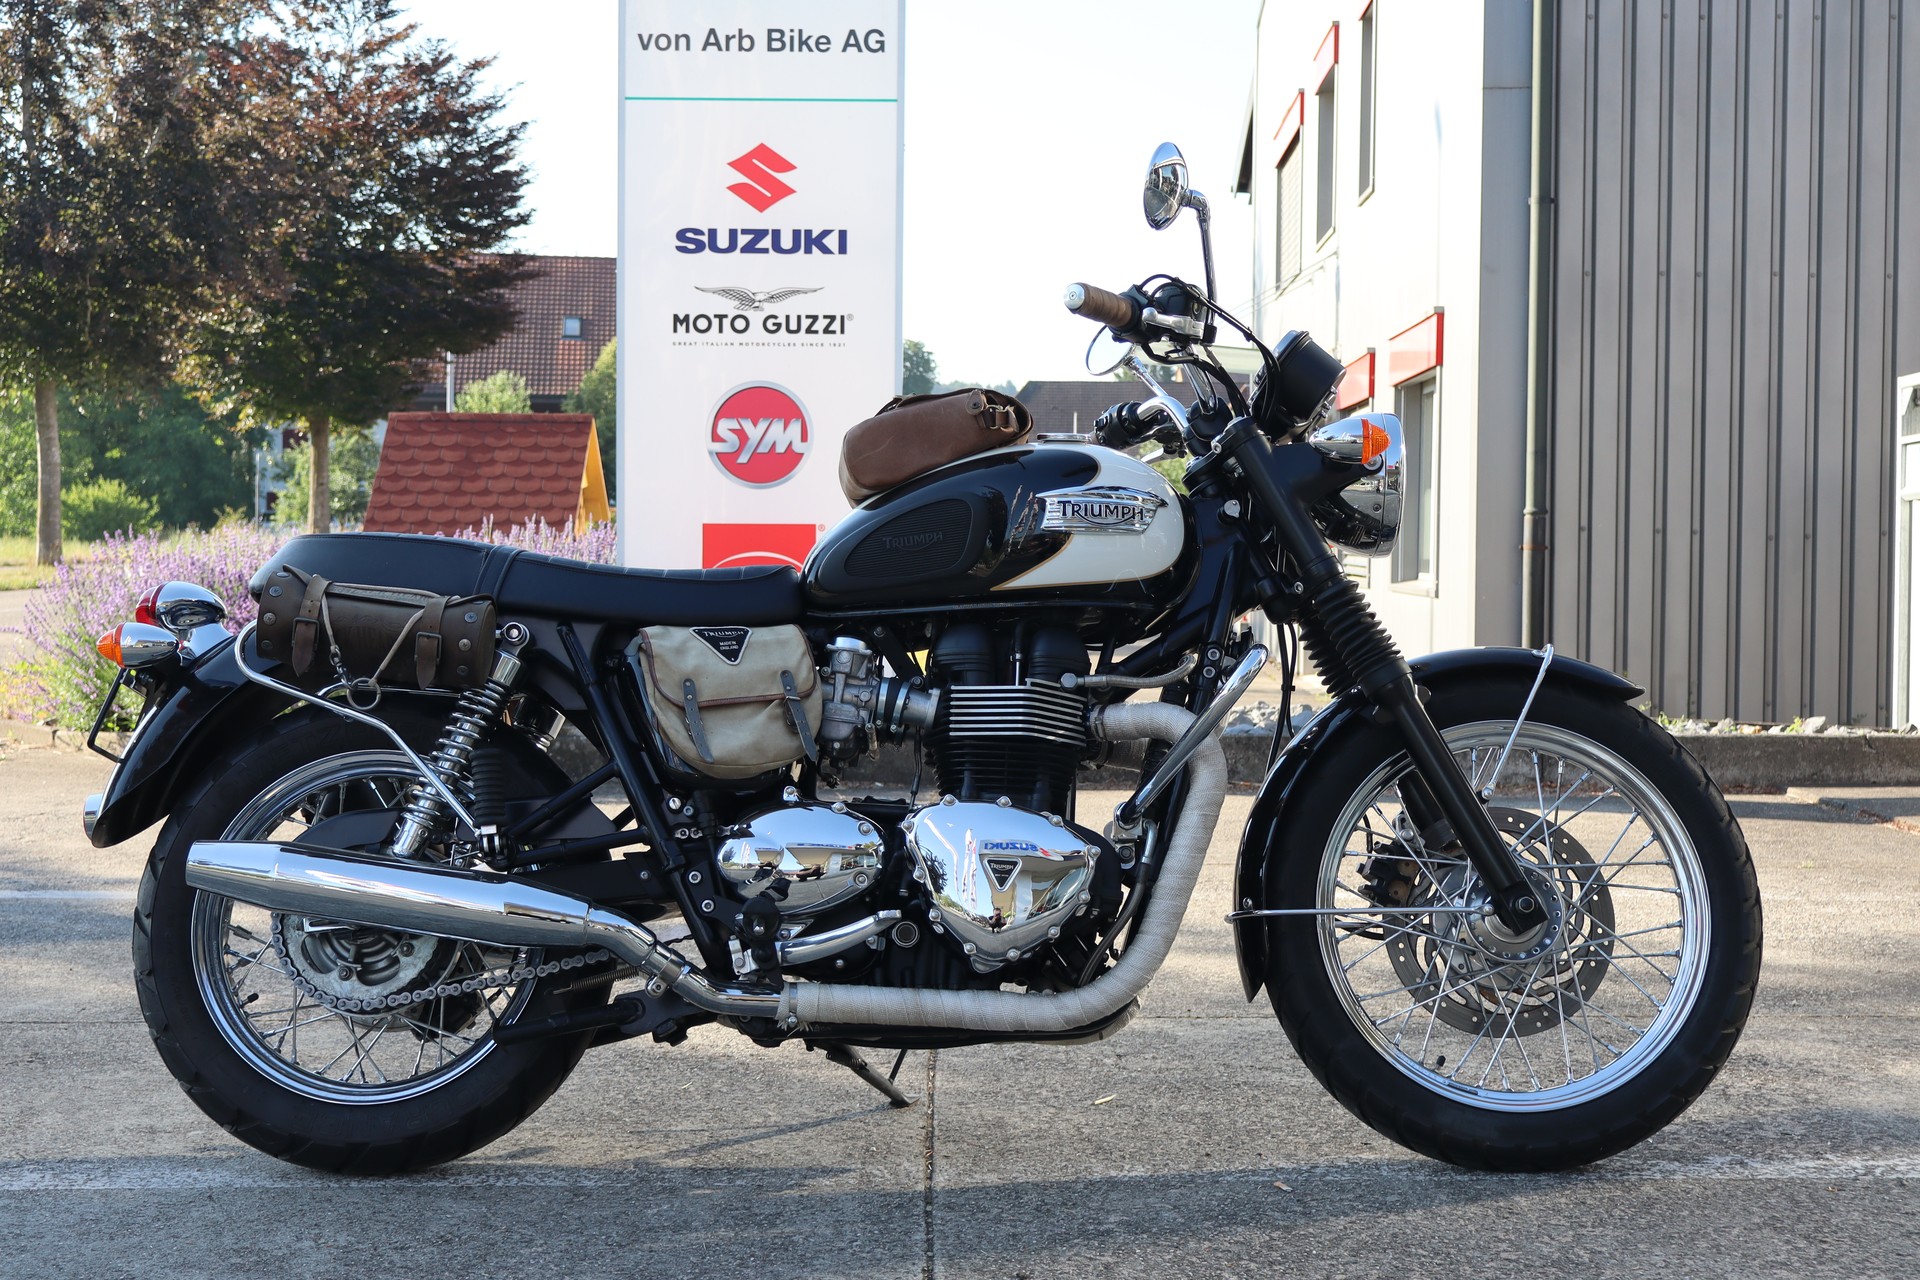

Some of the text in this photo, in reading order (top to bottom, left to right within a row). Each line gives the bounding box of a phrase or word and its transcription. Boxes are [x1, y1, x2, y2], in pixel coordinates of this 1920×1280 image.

[637, 28, 886, 53] von Arb Bike AG
[674, 227, 848, 255] SUZUKI
[673, 313, 751, 335] MOTO
[707, 417, 809, 464] SYM
[1057, 500, 1144, 524] TRIUMPH
[882, 531, 943, 550] TRIUMPH
